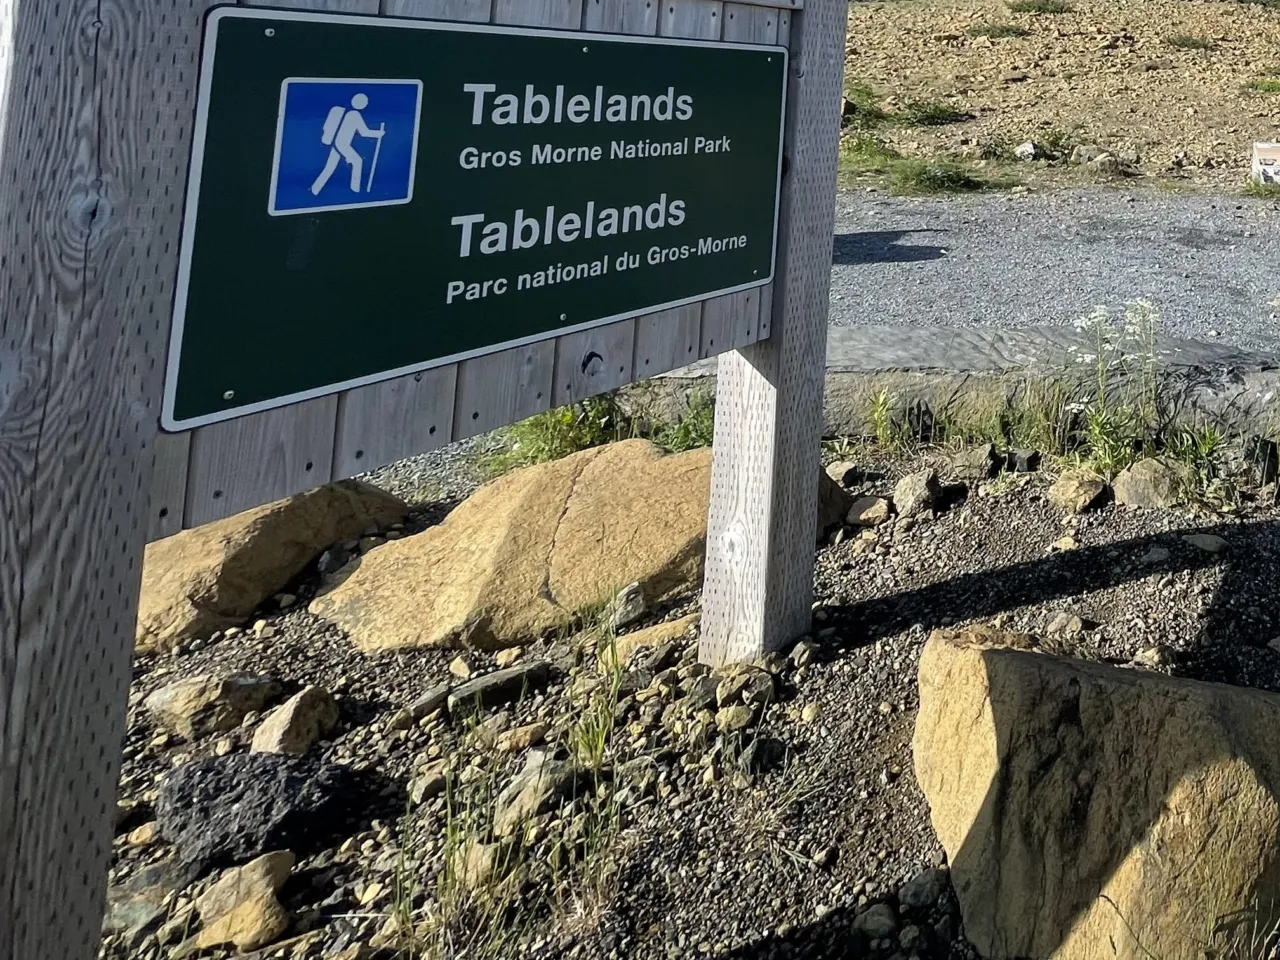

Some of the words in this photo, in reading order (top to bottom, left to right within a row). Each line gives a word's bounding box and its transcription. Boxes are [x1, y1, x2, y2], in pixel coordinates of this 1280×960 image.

[463, 83, 693, 125] Tablelands
[460, 146, 522, 170] Gros
[531, 143, 603, 165] Morne
[610, 137, 689, 160] National
[694, 135, 731, 154] Park
[450, 193, 686, 258] Tablelands
[446, 280, 508, 304] Parc
[517, 254, 609, 291] national
[616, 251, 640, 272] du
[647, 234, 746, 265] Gros-Morne
